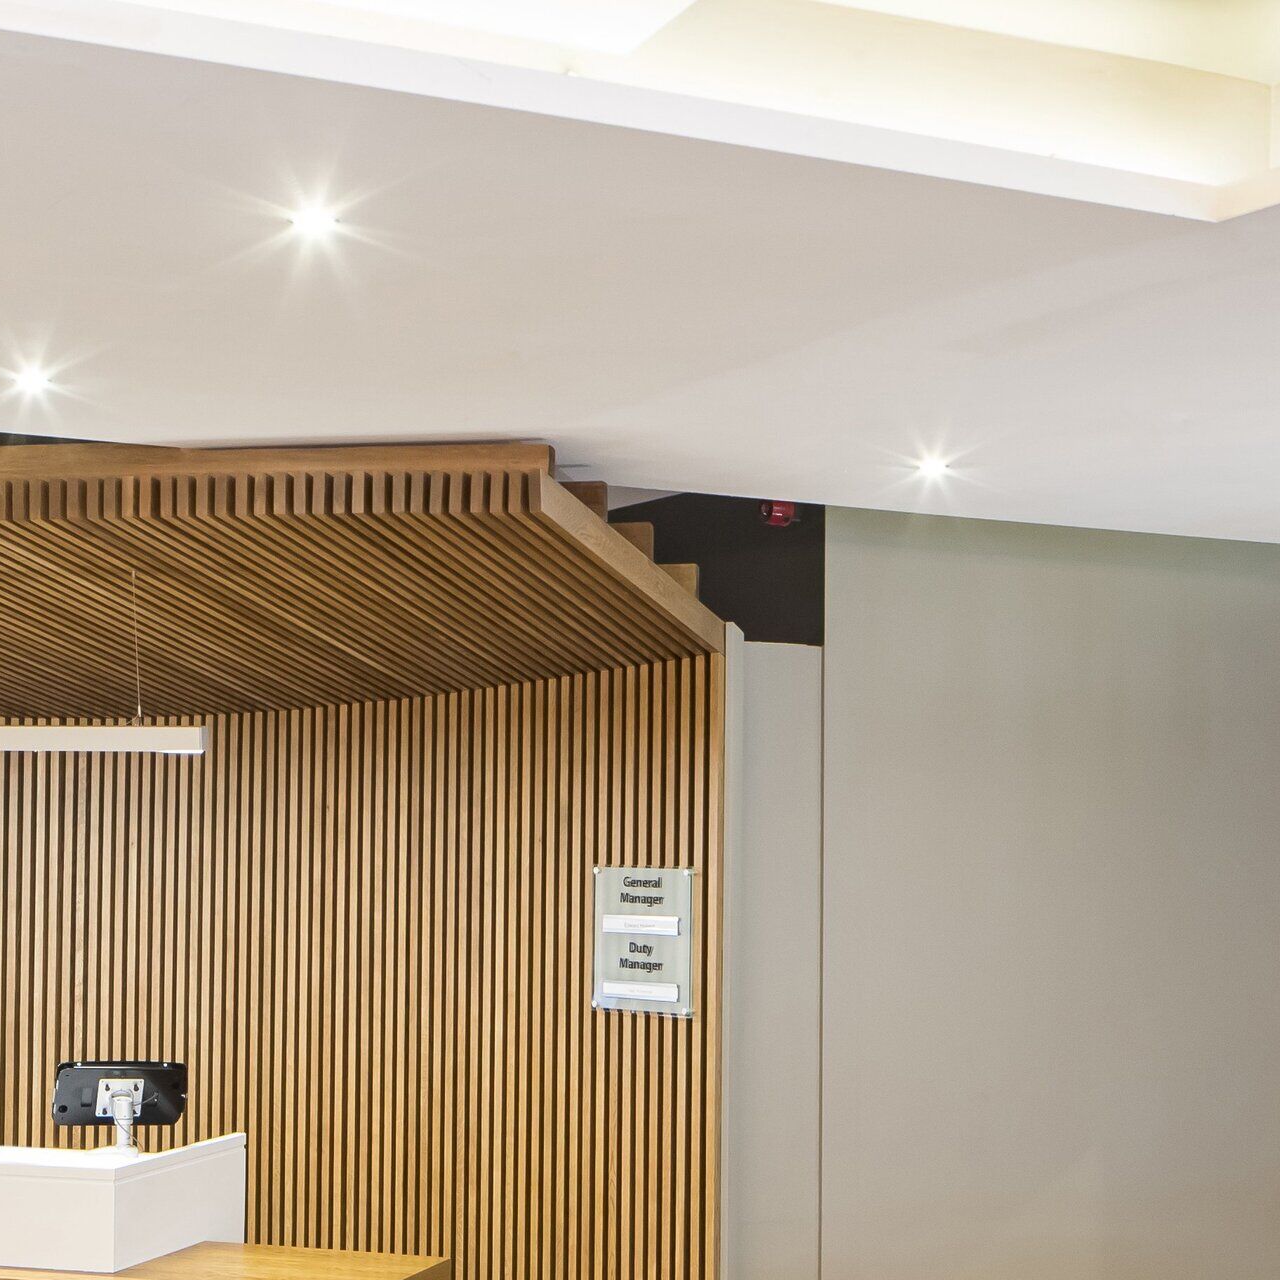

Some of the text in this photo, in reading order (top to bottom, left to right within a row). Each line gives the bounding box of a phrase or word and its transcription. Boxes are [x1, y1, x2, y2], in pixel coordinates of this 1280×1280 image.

[623, 876, 662, 888] General
[620, 892, 664, 907] Manager
[628, 942, 654, 957] Duty
[619, 958, 663, 973] Manager
